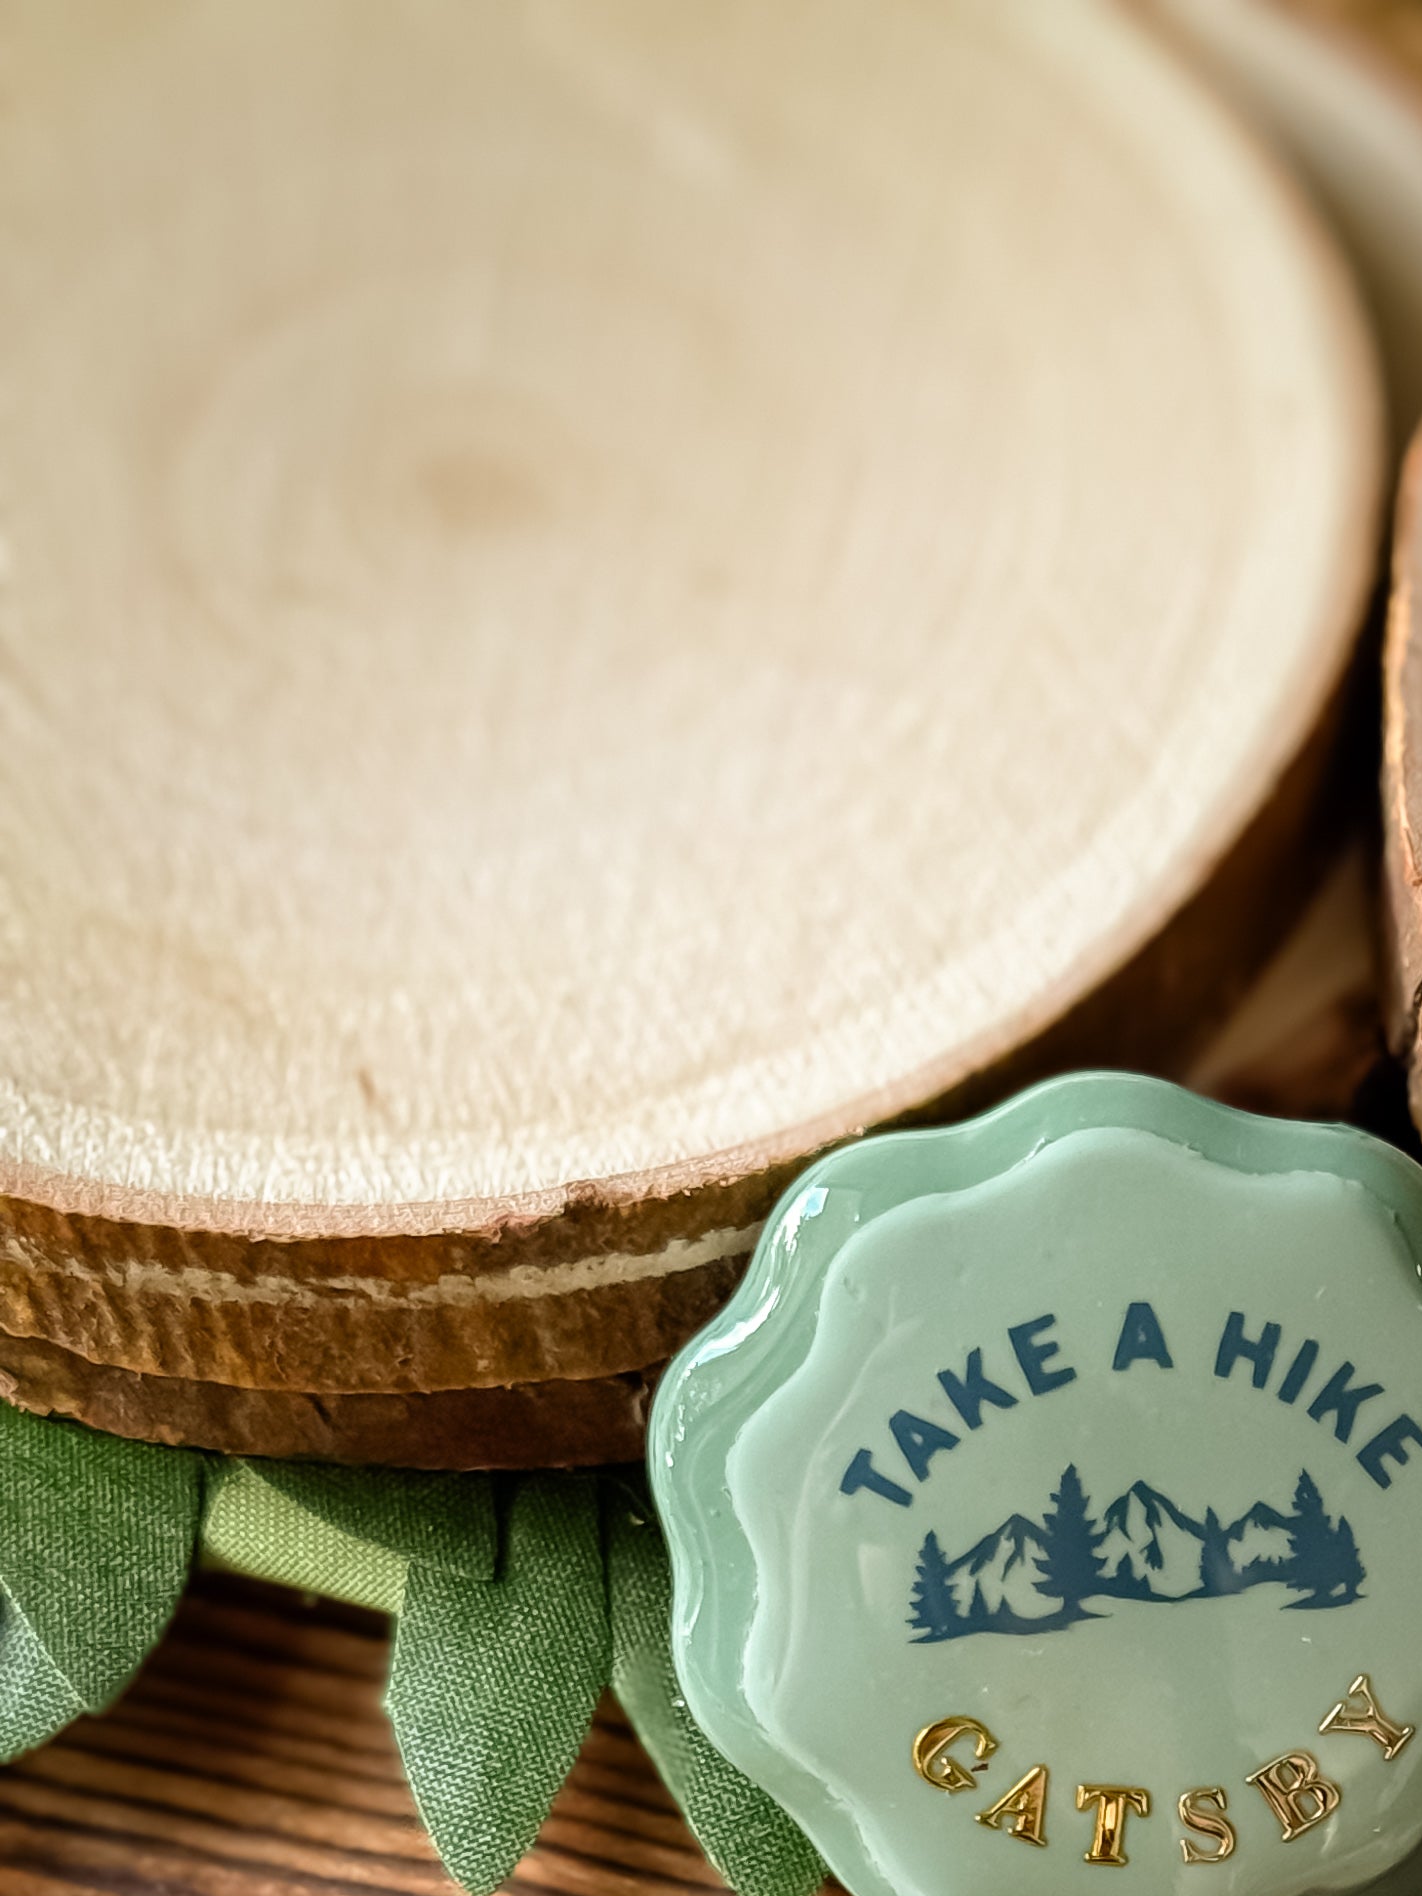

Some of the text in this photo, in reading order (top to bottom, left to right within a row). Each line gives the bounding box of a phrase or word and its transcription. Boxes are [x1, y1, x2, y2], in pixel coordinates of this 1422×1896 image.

[838, 1313, 1077, 1508] TAKE
[1111, 1301, 1174, 1371] A
[911, 1673, 1417, 1868] GATSBY
